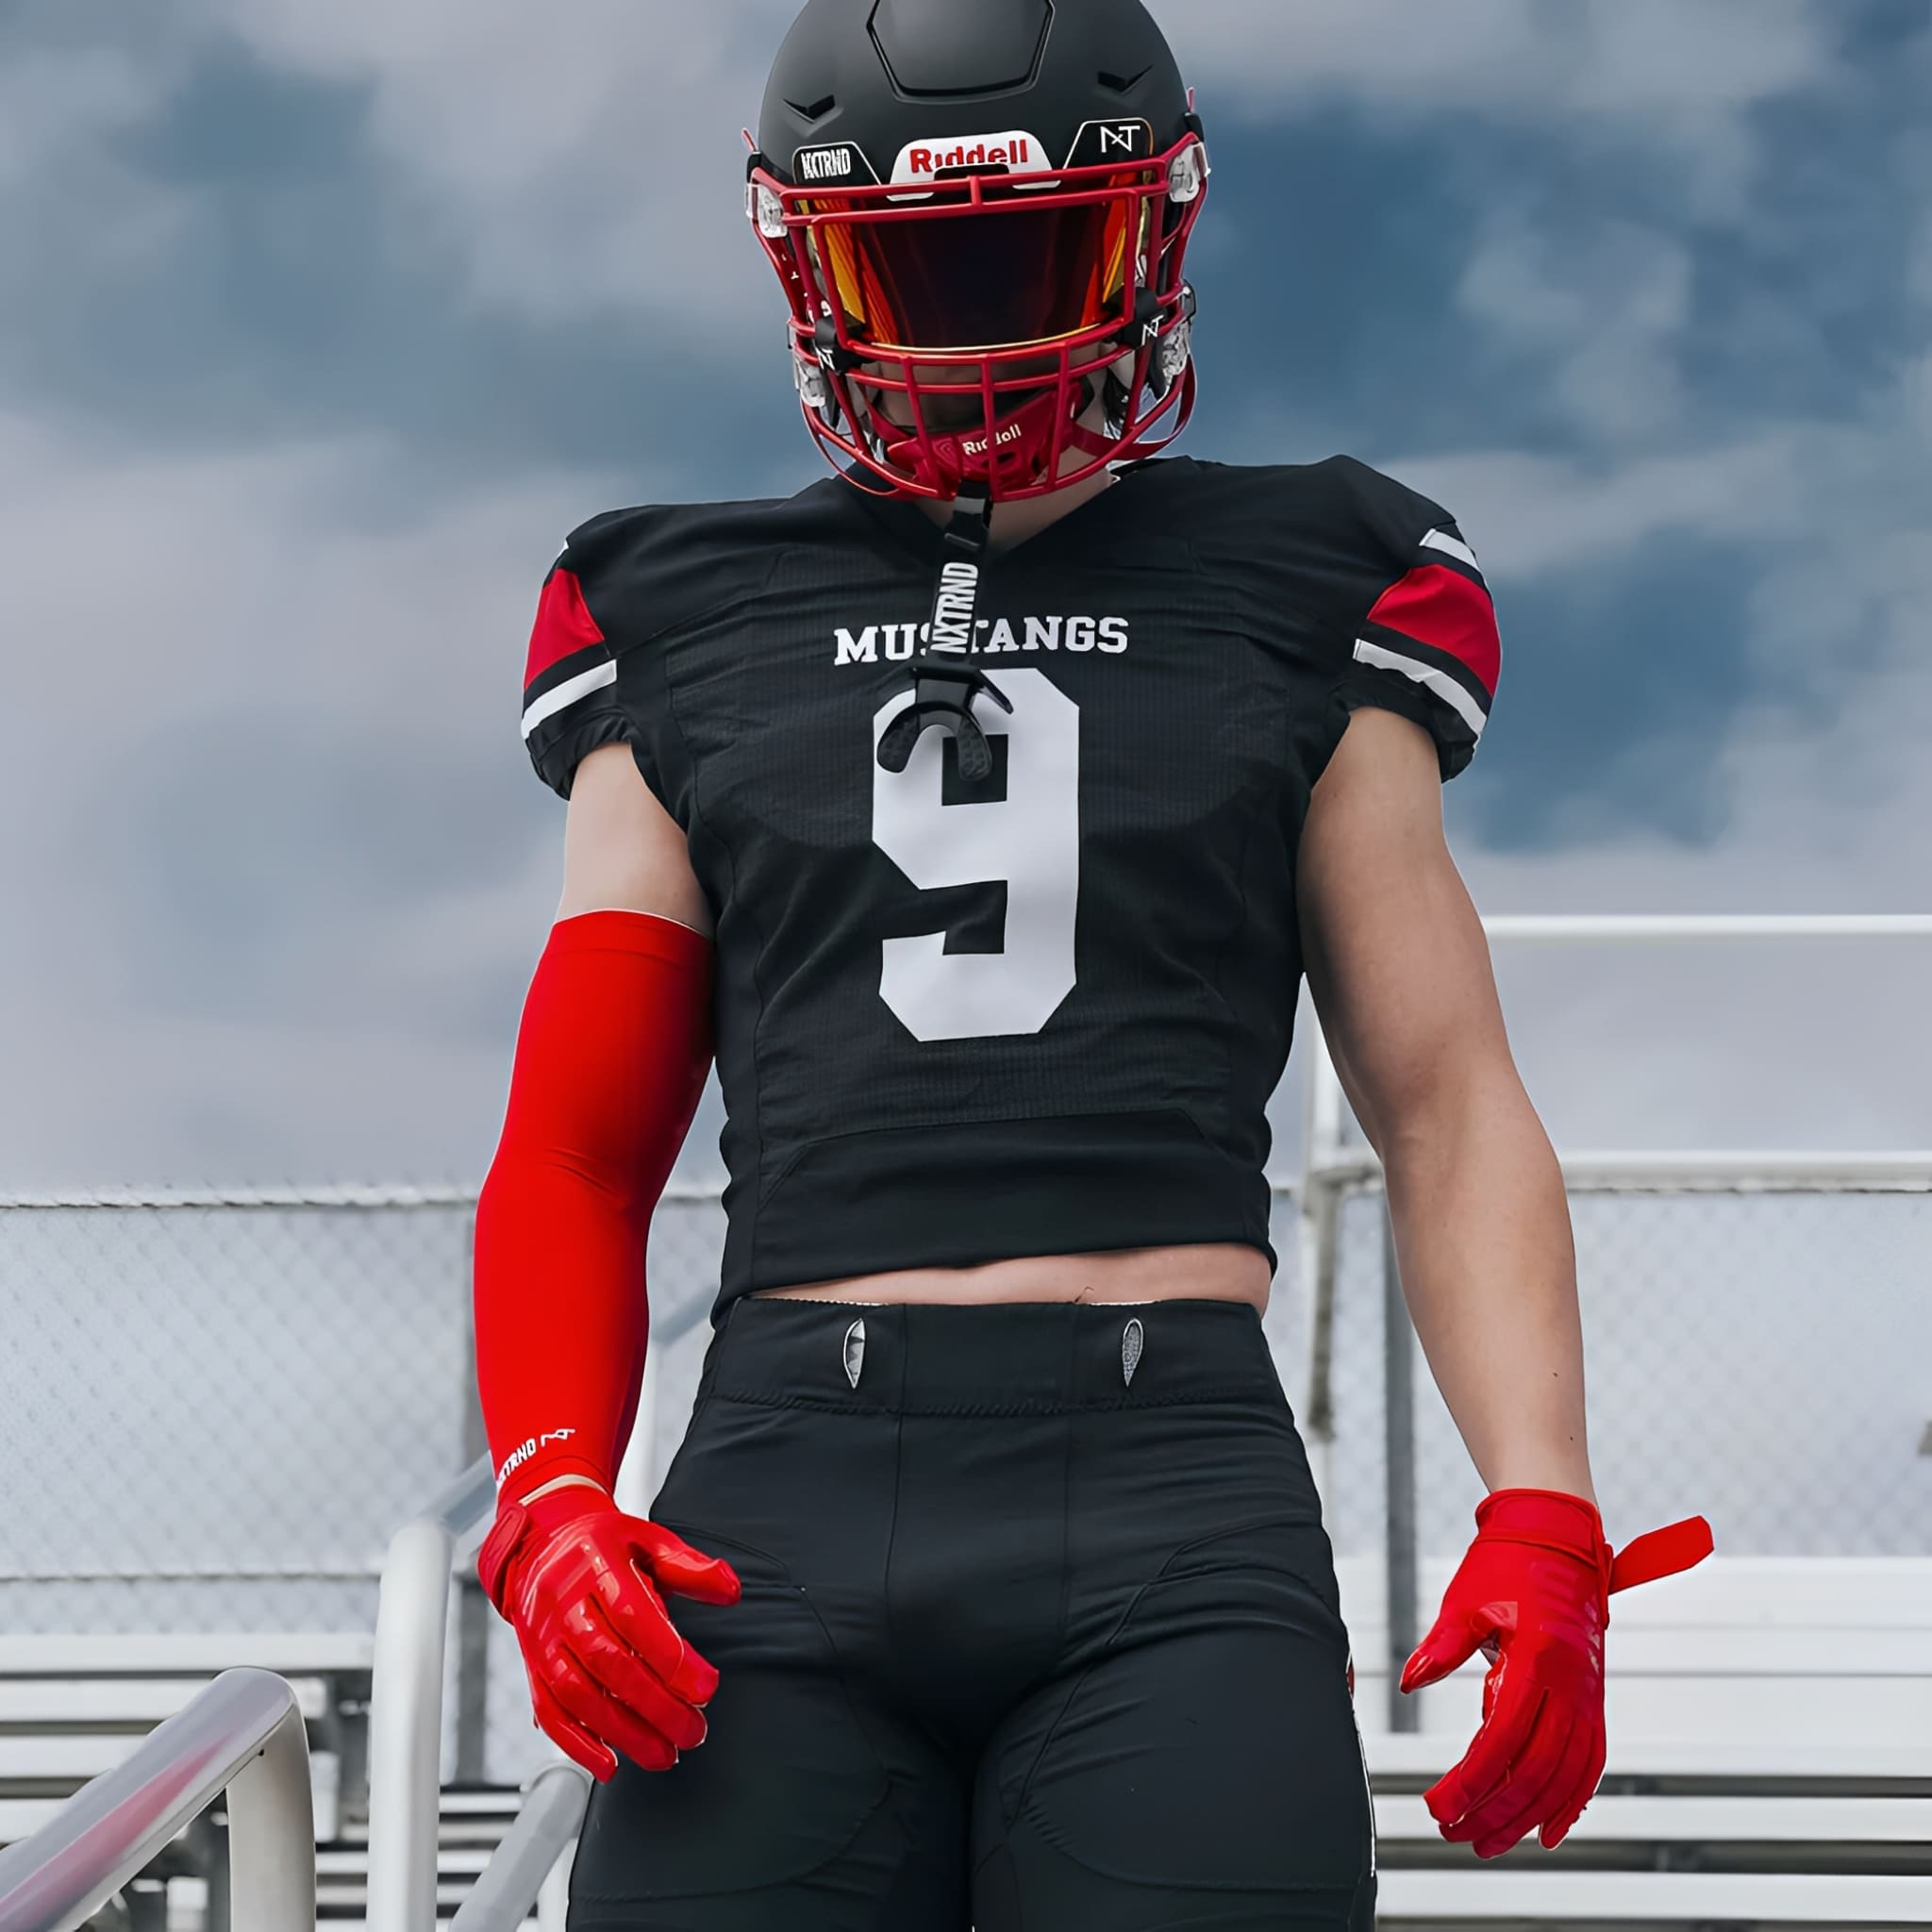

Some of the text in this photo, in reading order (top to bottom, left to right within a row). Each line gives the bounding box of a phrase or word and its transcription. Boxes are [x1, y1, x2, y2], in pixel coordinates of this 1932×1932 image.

[909, 139, 1028, 174] Riddell
[930, 562, 978, 653] NXTRND
[834, 616, 1129, 666] MUTANGS
[873, 668, 1079, 1041] 9
[497, 1438, 537, 1482] TRND
